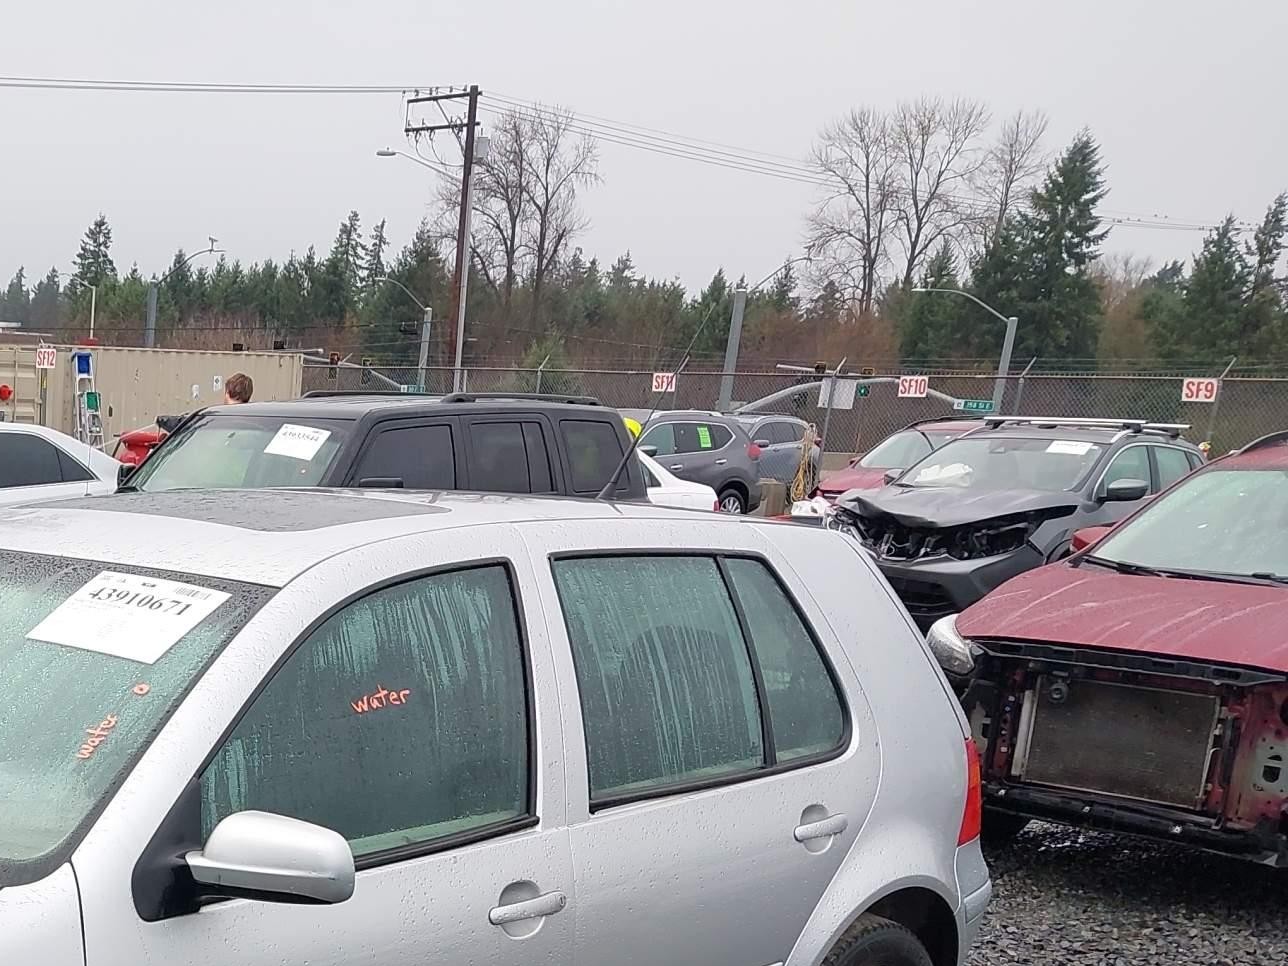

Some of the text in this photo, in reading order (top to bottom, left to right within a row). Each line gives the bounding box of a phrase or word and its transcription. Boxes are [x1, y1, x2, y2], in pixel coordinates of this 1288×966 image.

[37, 350, 56, 367] SF12
[900, 378, 927, 395] SF10
[1184, 380, 1215, 400] SF9
[87, 586, 193, 617] 43910671
[350, 684, 411, 713] water
